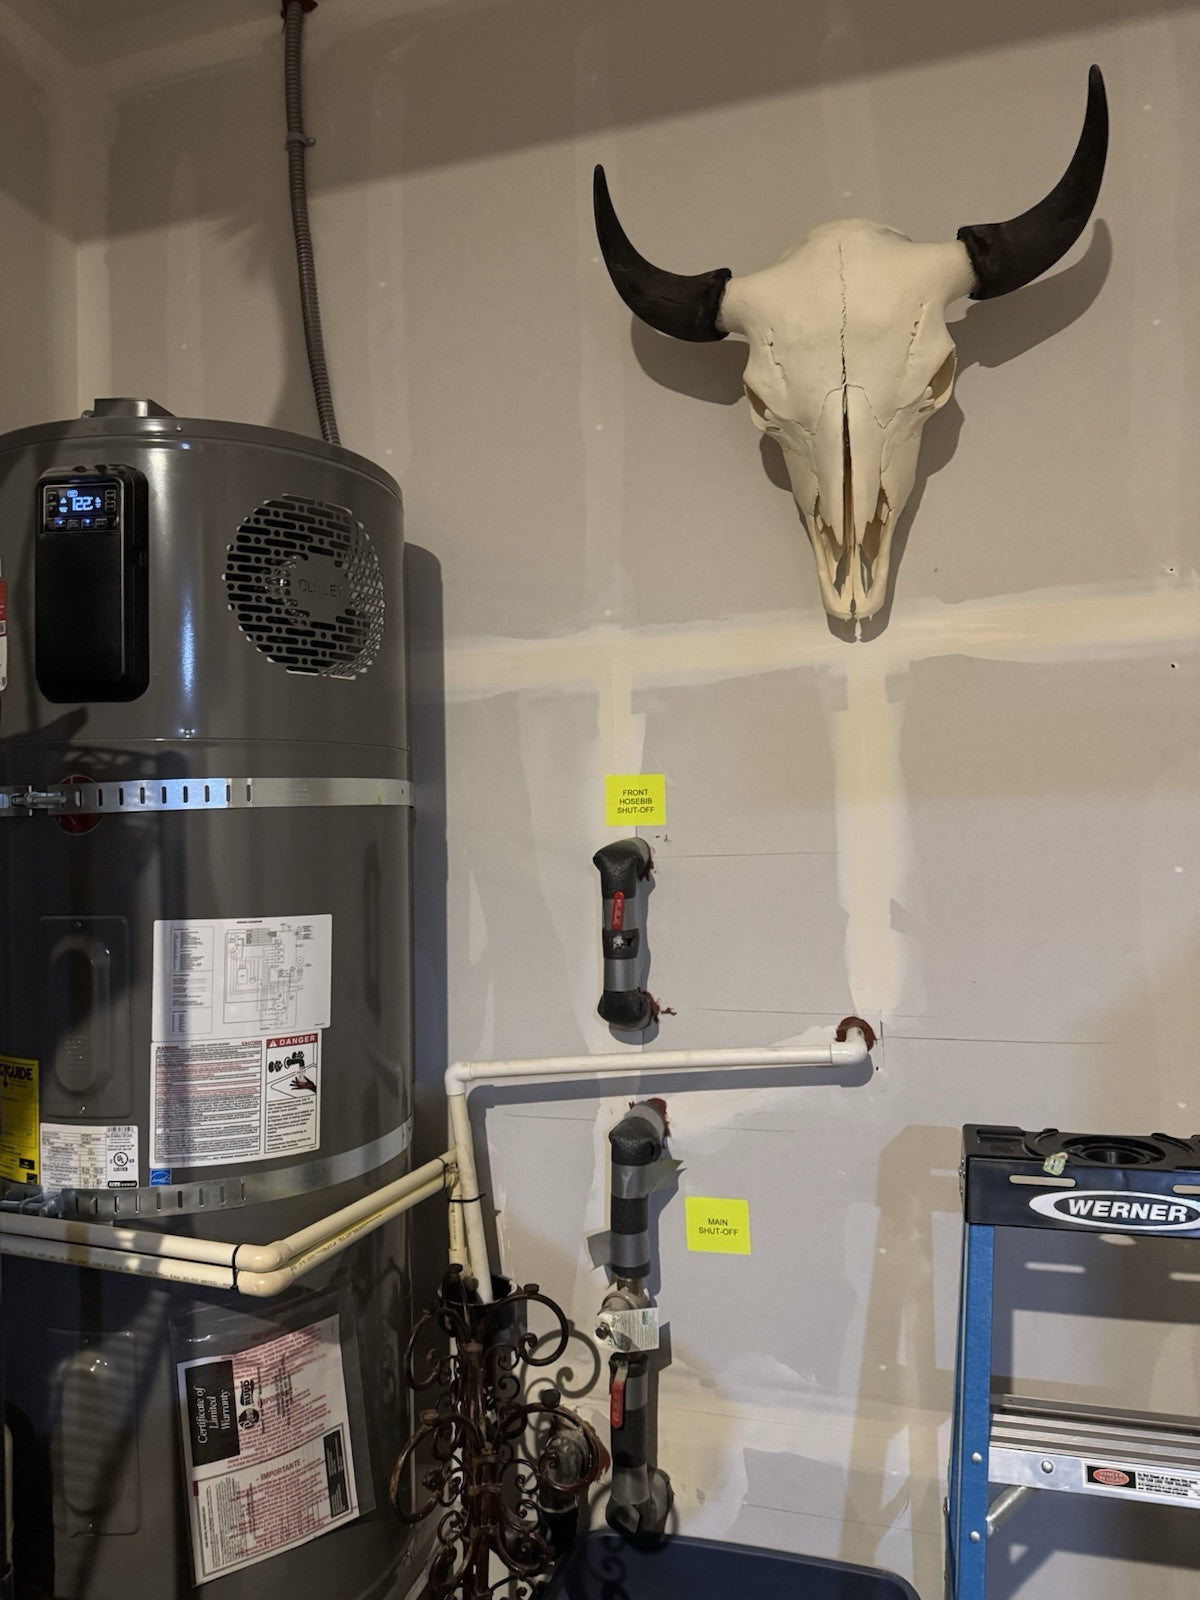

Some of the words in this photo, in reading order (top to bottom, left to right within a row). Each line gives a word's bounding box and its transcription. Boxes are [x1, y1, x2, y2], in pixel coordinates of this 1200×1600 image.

[617, 806, 655, 814] SHUT-OFF
[279, 1034, 316, 1047] DANGER
[1068, 1199, 1188, 1222] WERNER
[708, 1218, 729, 1226] MAIN
[698, 1226, 739, 1236] SHUT-OFF
[193, 1385, 207, 1397] of
[206, 1395, 219, 1429] Limited
[220, 1389, 231, 1430] Warranty
[195, 1398, 209, 1444] Certificate
